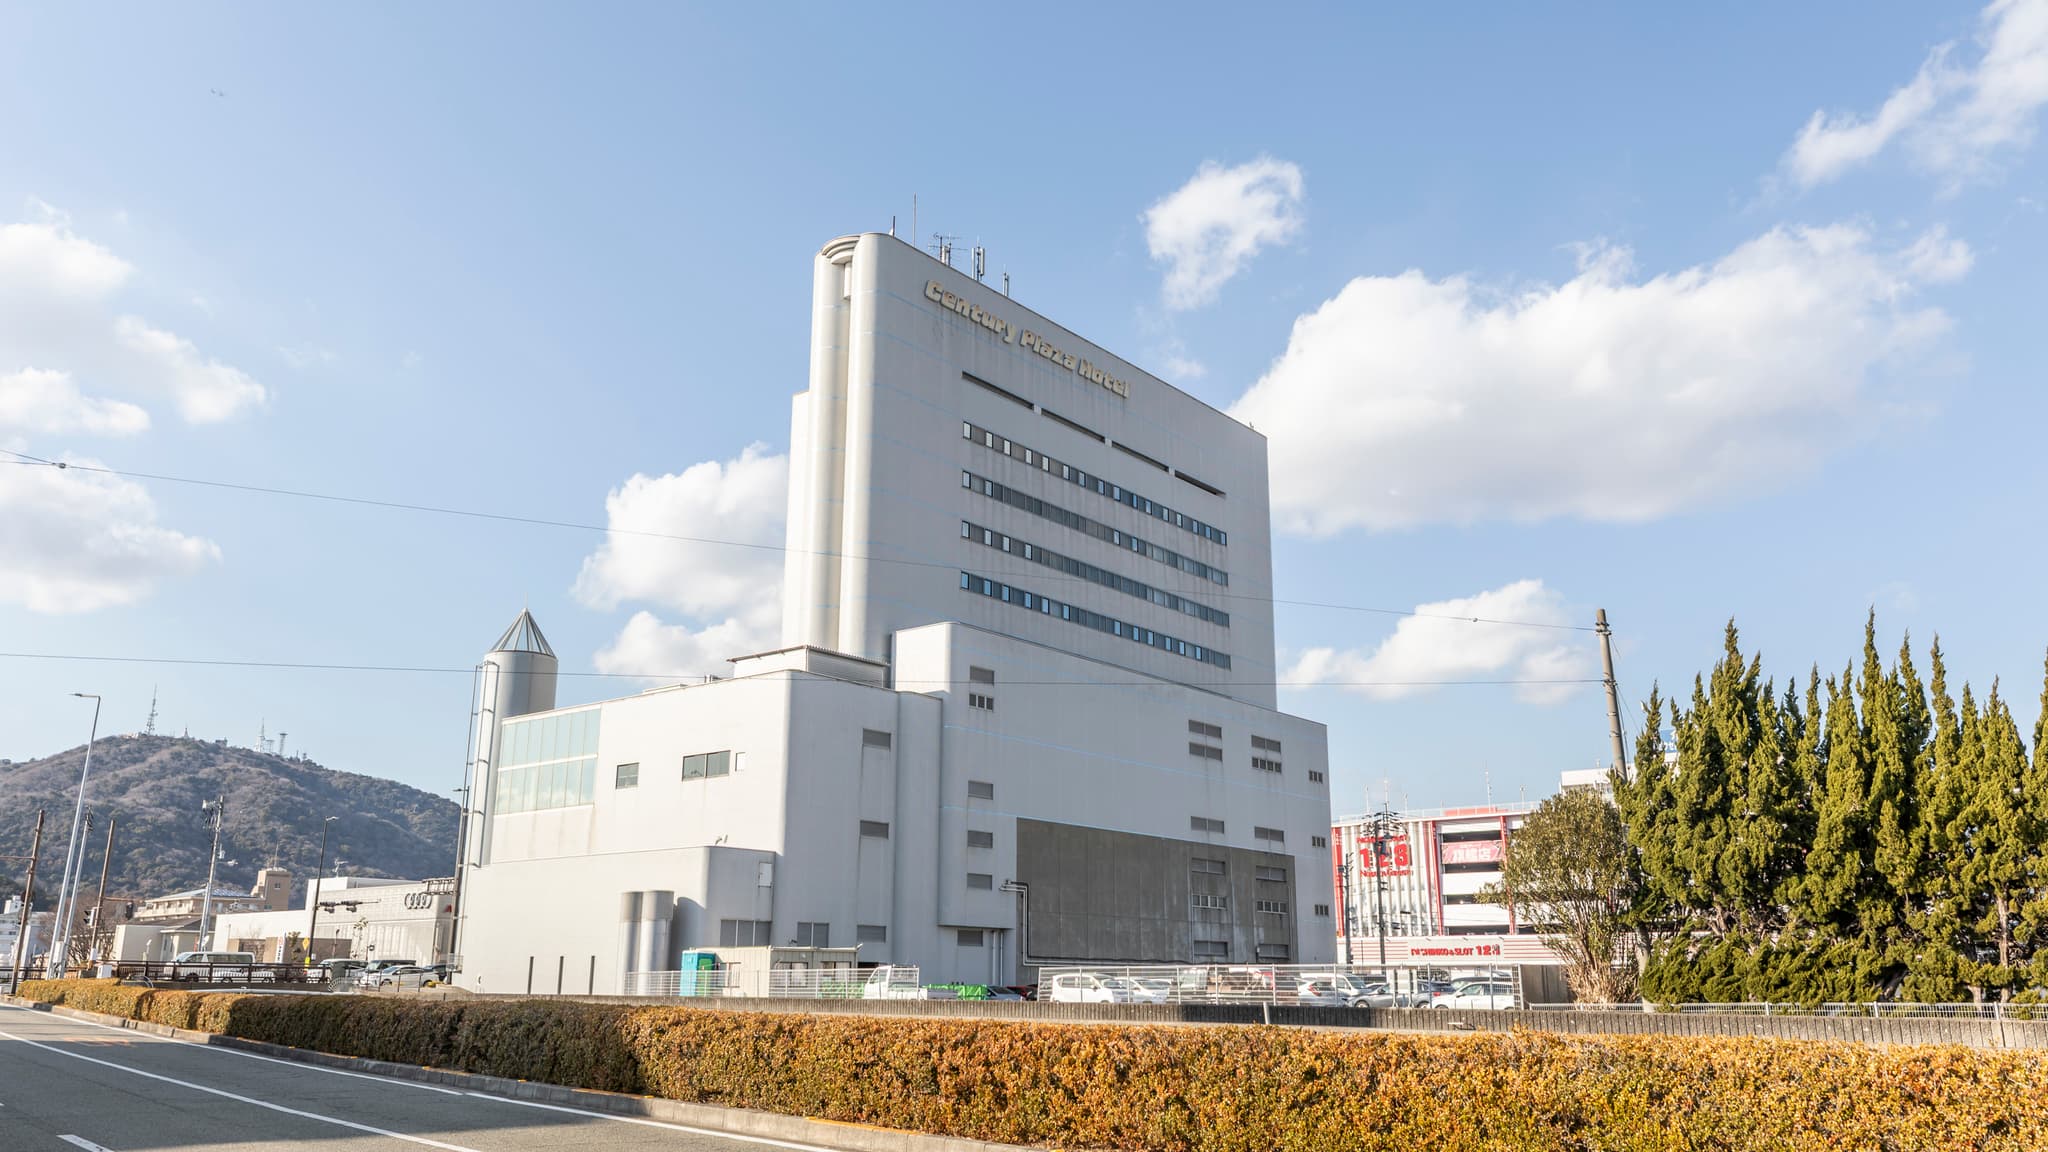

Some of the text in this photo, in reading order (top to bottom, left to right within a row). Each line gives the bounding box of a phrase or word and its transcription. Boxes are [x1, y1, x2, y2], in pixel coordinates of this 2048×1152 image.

[925, 279, 1130, 398] Century Plaza Hotel
